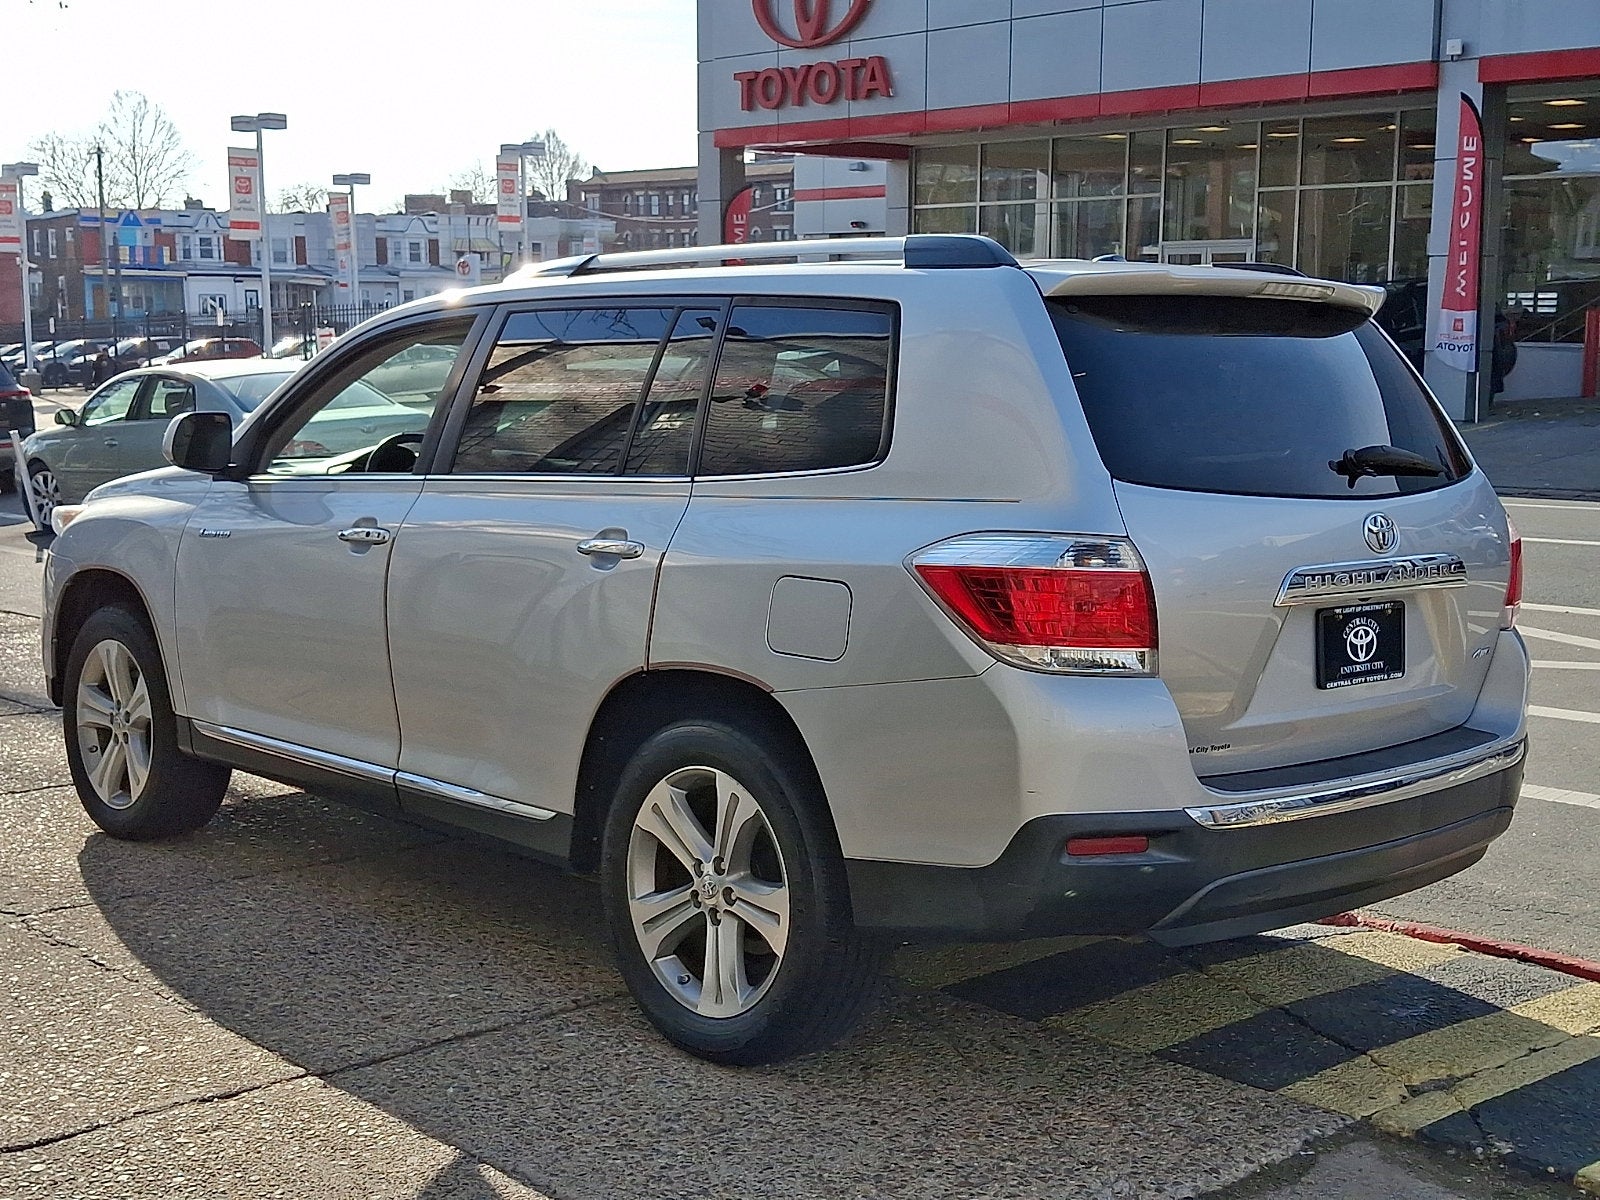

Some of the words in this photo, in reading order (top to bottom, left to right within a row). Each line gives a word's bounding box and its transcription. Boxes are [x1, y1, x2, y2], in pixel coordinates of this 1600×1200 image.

[734, 56, 893, 112] TOYOTA
[1305, 563, 1451, 590] HIGHLANDER
[1343, 616, 1367, 639] CENTRAL
[1367, 617, 1381, 634] CITY
[1340, 662, 1371, 675] UNIVERSITY
[1371, 660, 1385, 670] CITY
[1326, 681, 1351, 689] CENTRAL
[1366, 673, 1388, 682] TOYOTA
[1210, 743, 1231, 751] Toyota
